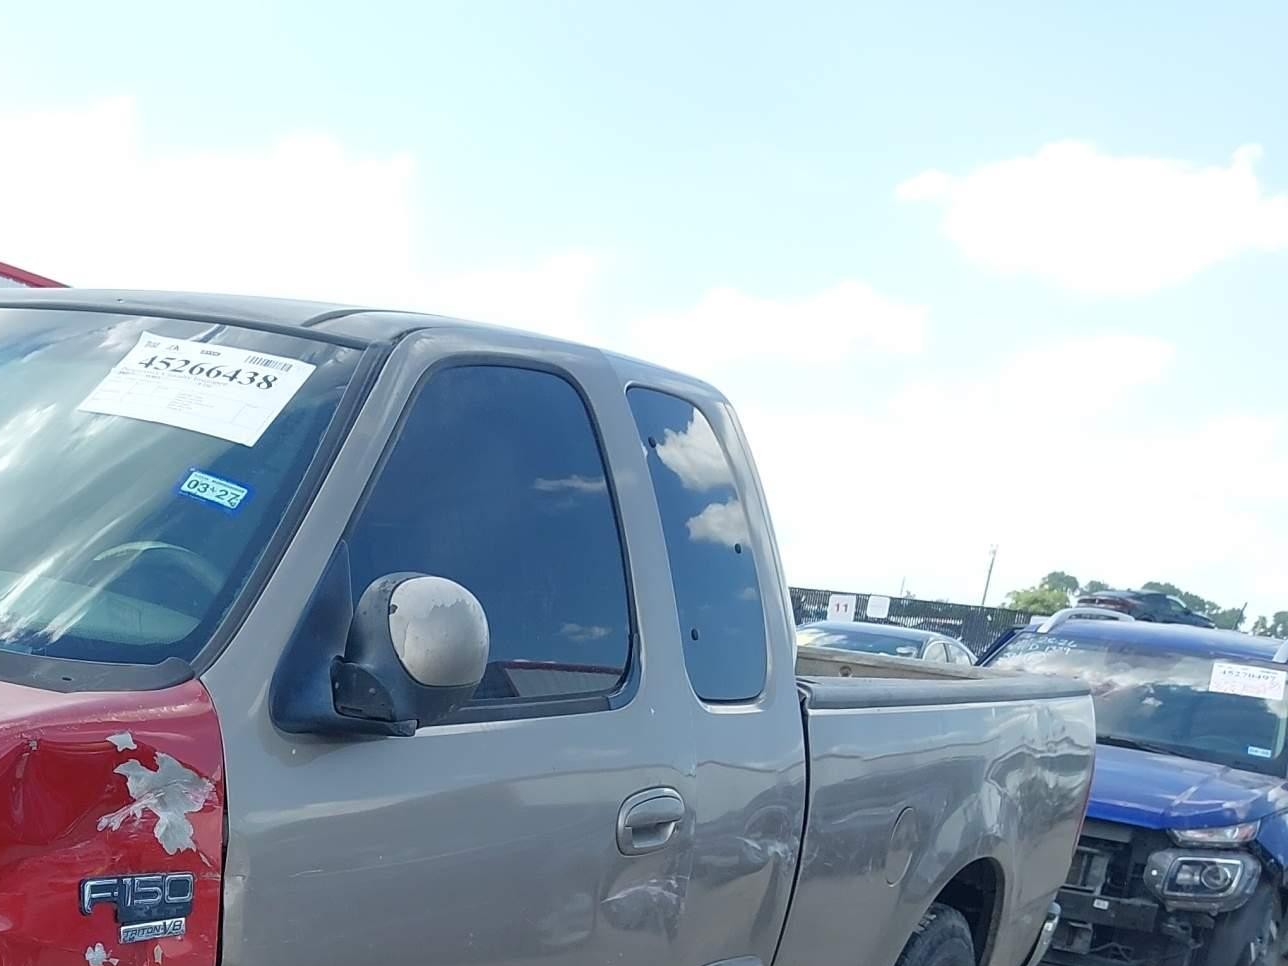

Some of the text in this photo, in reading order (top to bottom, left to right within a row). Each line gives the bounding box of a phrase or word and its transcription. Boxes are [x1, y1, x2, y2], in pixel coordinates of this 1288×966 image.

[138, 355, 279, 390] 45266438
[187, 479, 210, 494] 03
[215, 489, 241, 503] 27
[834, 602, 849, 613] 11
